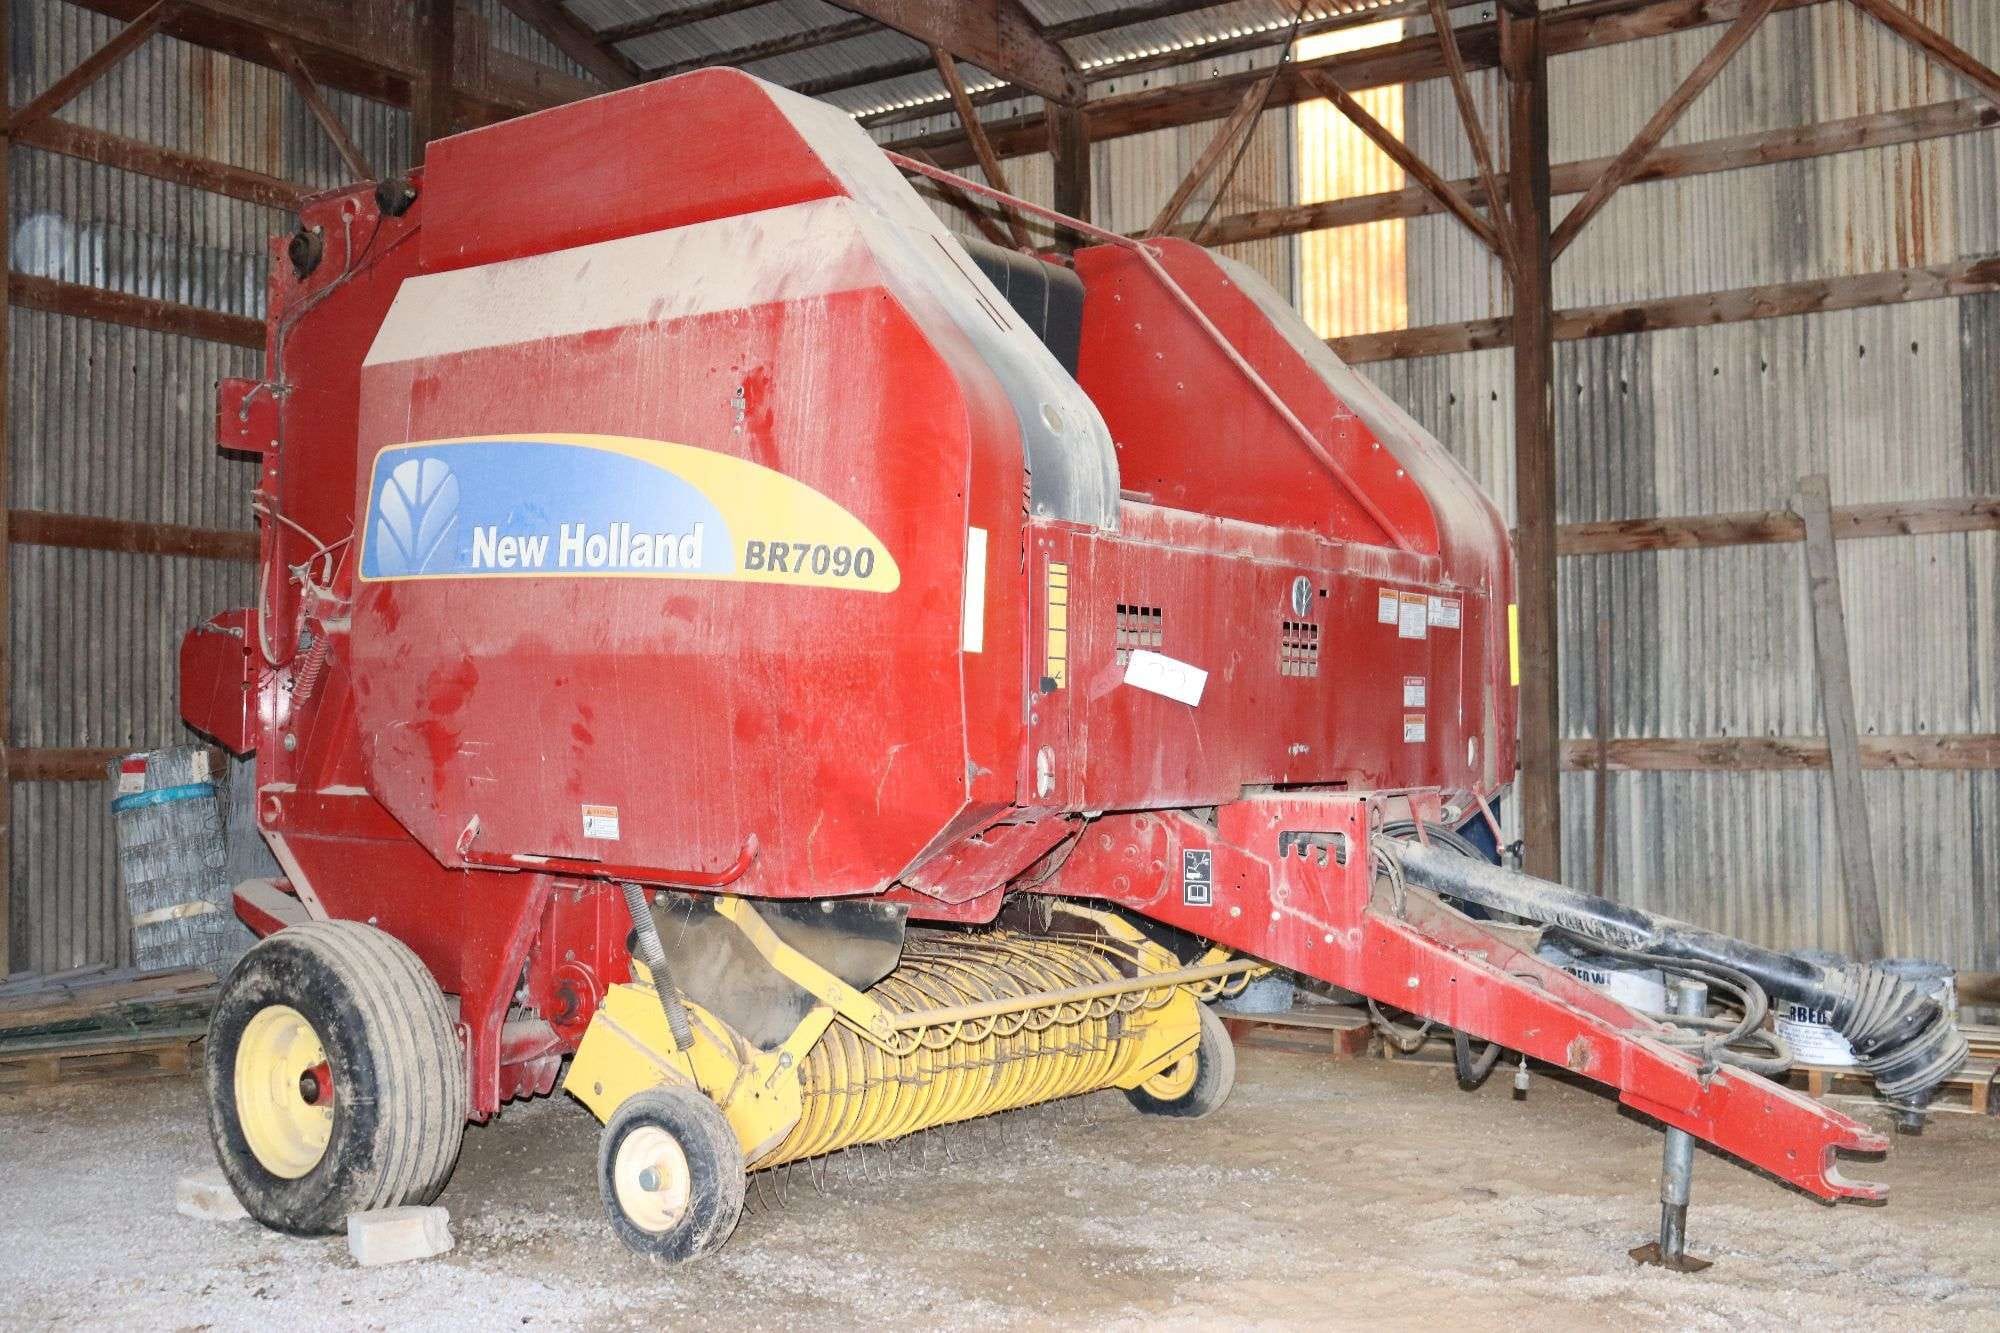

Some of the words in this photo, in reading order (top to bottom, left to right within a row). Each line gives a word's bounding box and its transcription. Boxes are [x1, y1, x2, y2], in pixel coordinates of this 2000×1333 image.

[471, 524, 549, 568] New
[558, 521, 704, 568] Holland
[744, 540, 876, 578] BR7090
